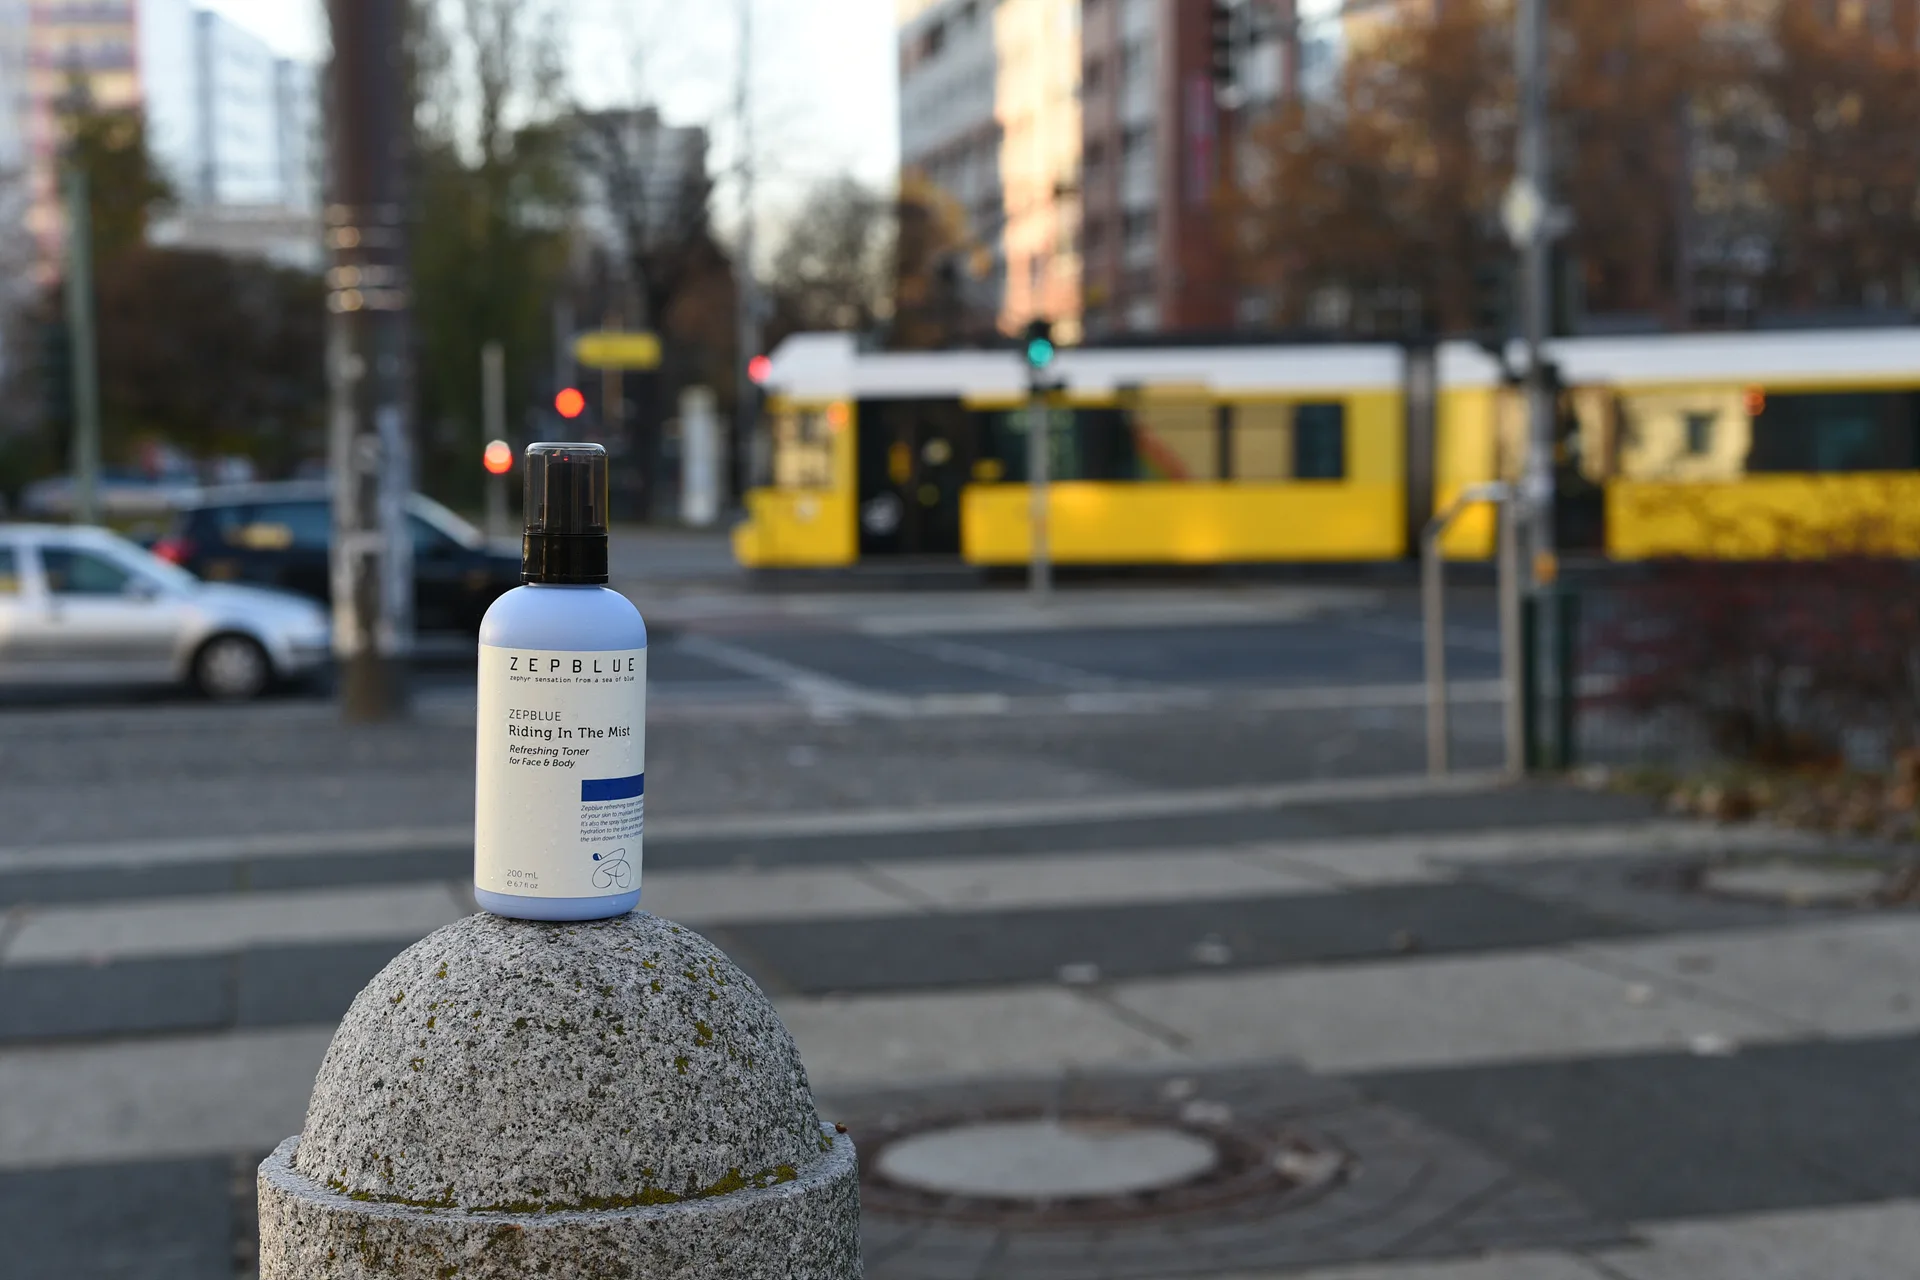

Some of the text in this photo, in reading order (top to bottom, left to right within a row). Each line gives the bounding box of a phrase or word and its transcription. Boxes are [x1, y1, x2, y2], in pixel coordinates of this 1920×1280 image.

[510, 656, 635, 673] ZEPBLUE
[509, 708, 561, 721] ZEPBLUE
[509, 725, 630, 741] Riding In The Mist
[509, 744, 589, 757] Refreshing Toner
[509, 757, 575, 769] for Face & Body
[507, 869, 538, 879] 200 mL
